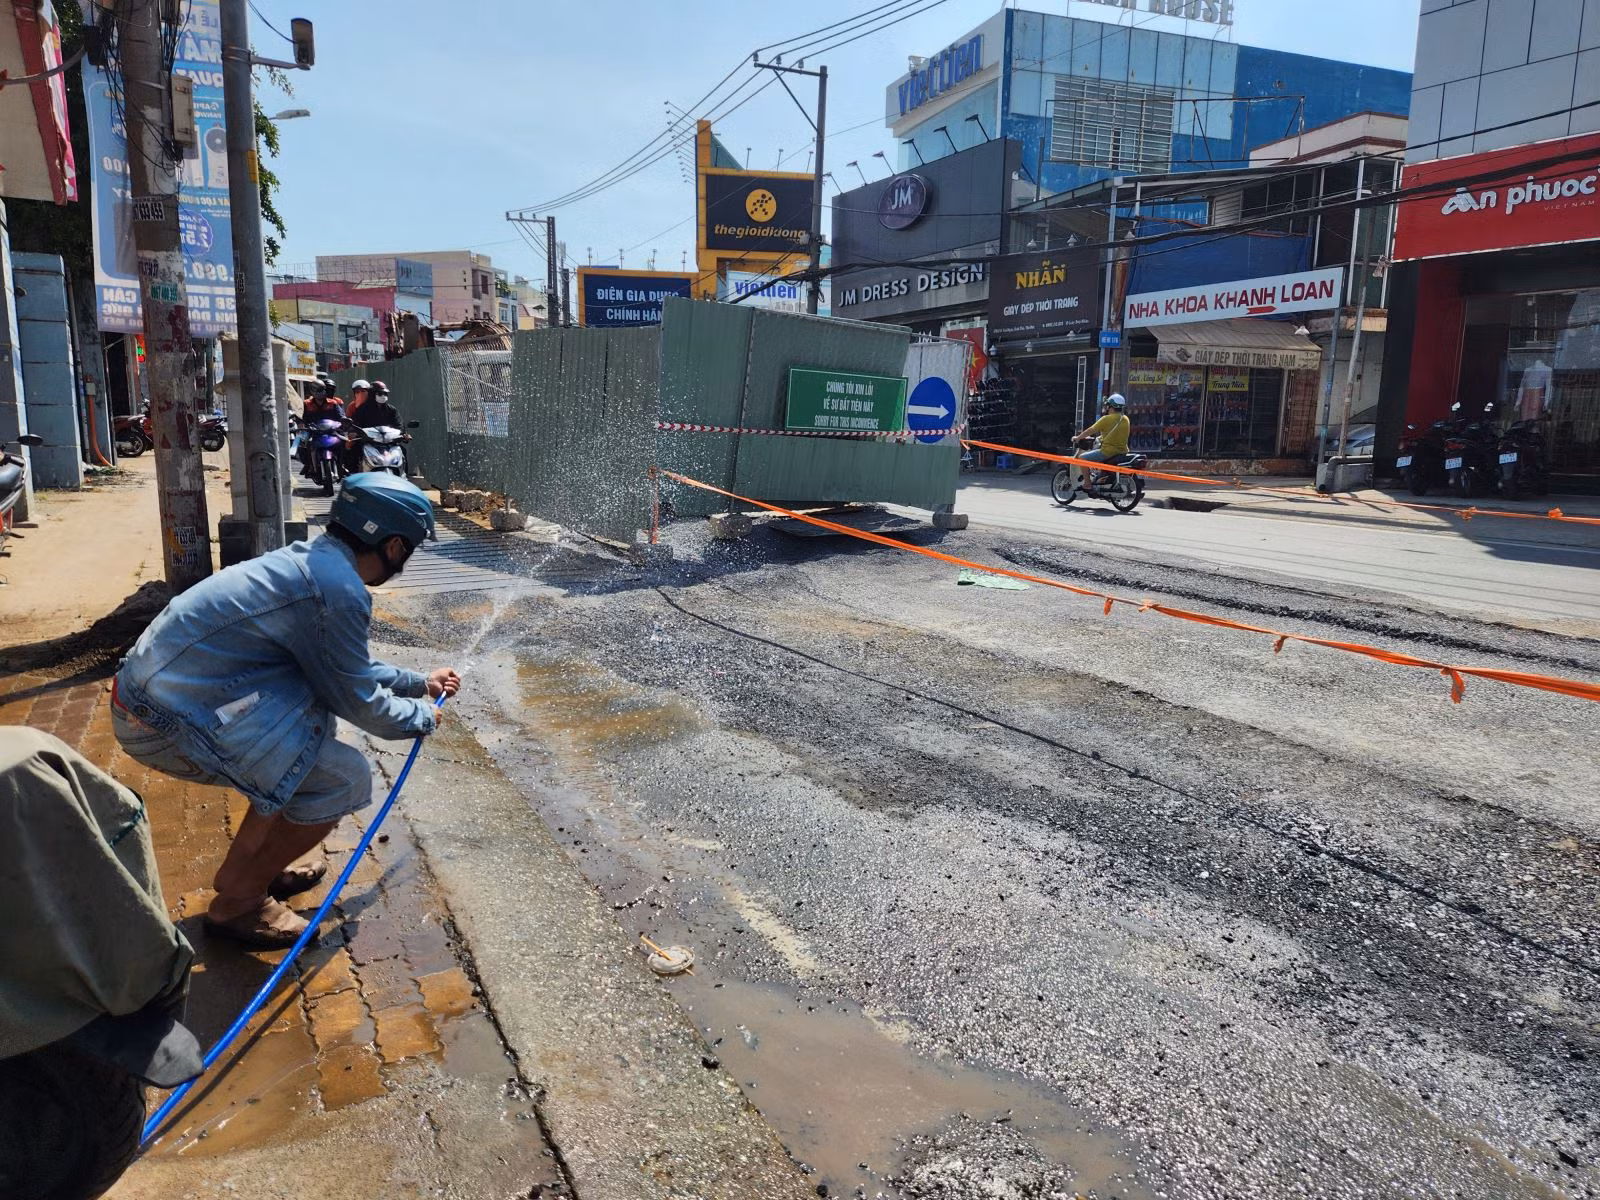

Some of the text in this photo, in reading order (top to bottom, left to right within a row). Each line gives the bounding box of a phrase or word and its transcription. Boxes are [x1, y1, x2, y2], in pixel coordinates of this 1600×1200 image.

[891, 185, 912, 210] JM
[1505, 175, 1597, 215] phuoc
[838, 262, 984, 307] JM DRESS DESIGN
[596, 286, 624, 303] ĐIỆN
[627, 290, 646, 302] GIA
[1129, 279, 1334, 319] NHA KHOA KHANH LOAN
[1054, 296, 1079, 310] TRANG
[606, 307, 640, 320] CHÍNH
[1252, 352, 1277, 367] TRANG
[1279, 354, 1296, 367] NAM
[826, 380, 845, 394] CHÚNG
[845, 381, 855, 395] TÔI
[855, 383, 865, 396] XIN
[814, 415, 829, 427] SORRY
[829, 416, 839, 427] FOR
[839, 416, 850, 428] THIS
